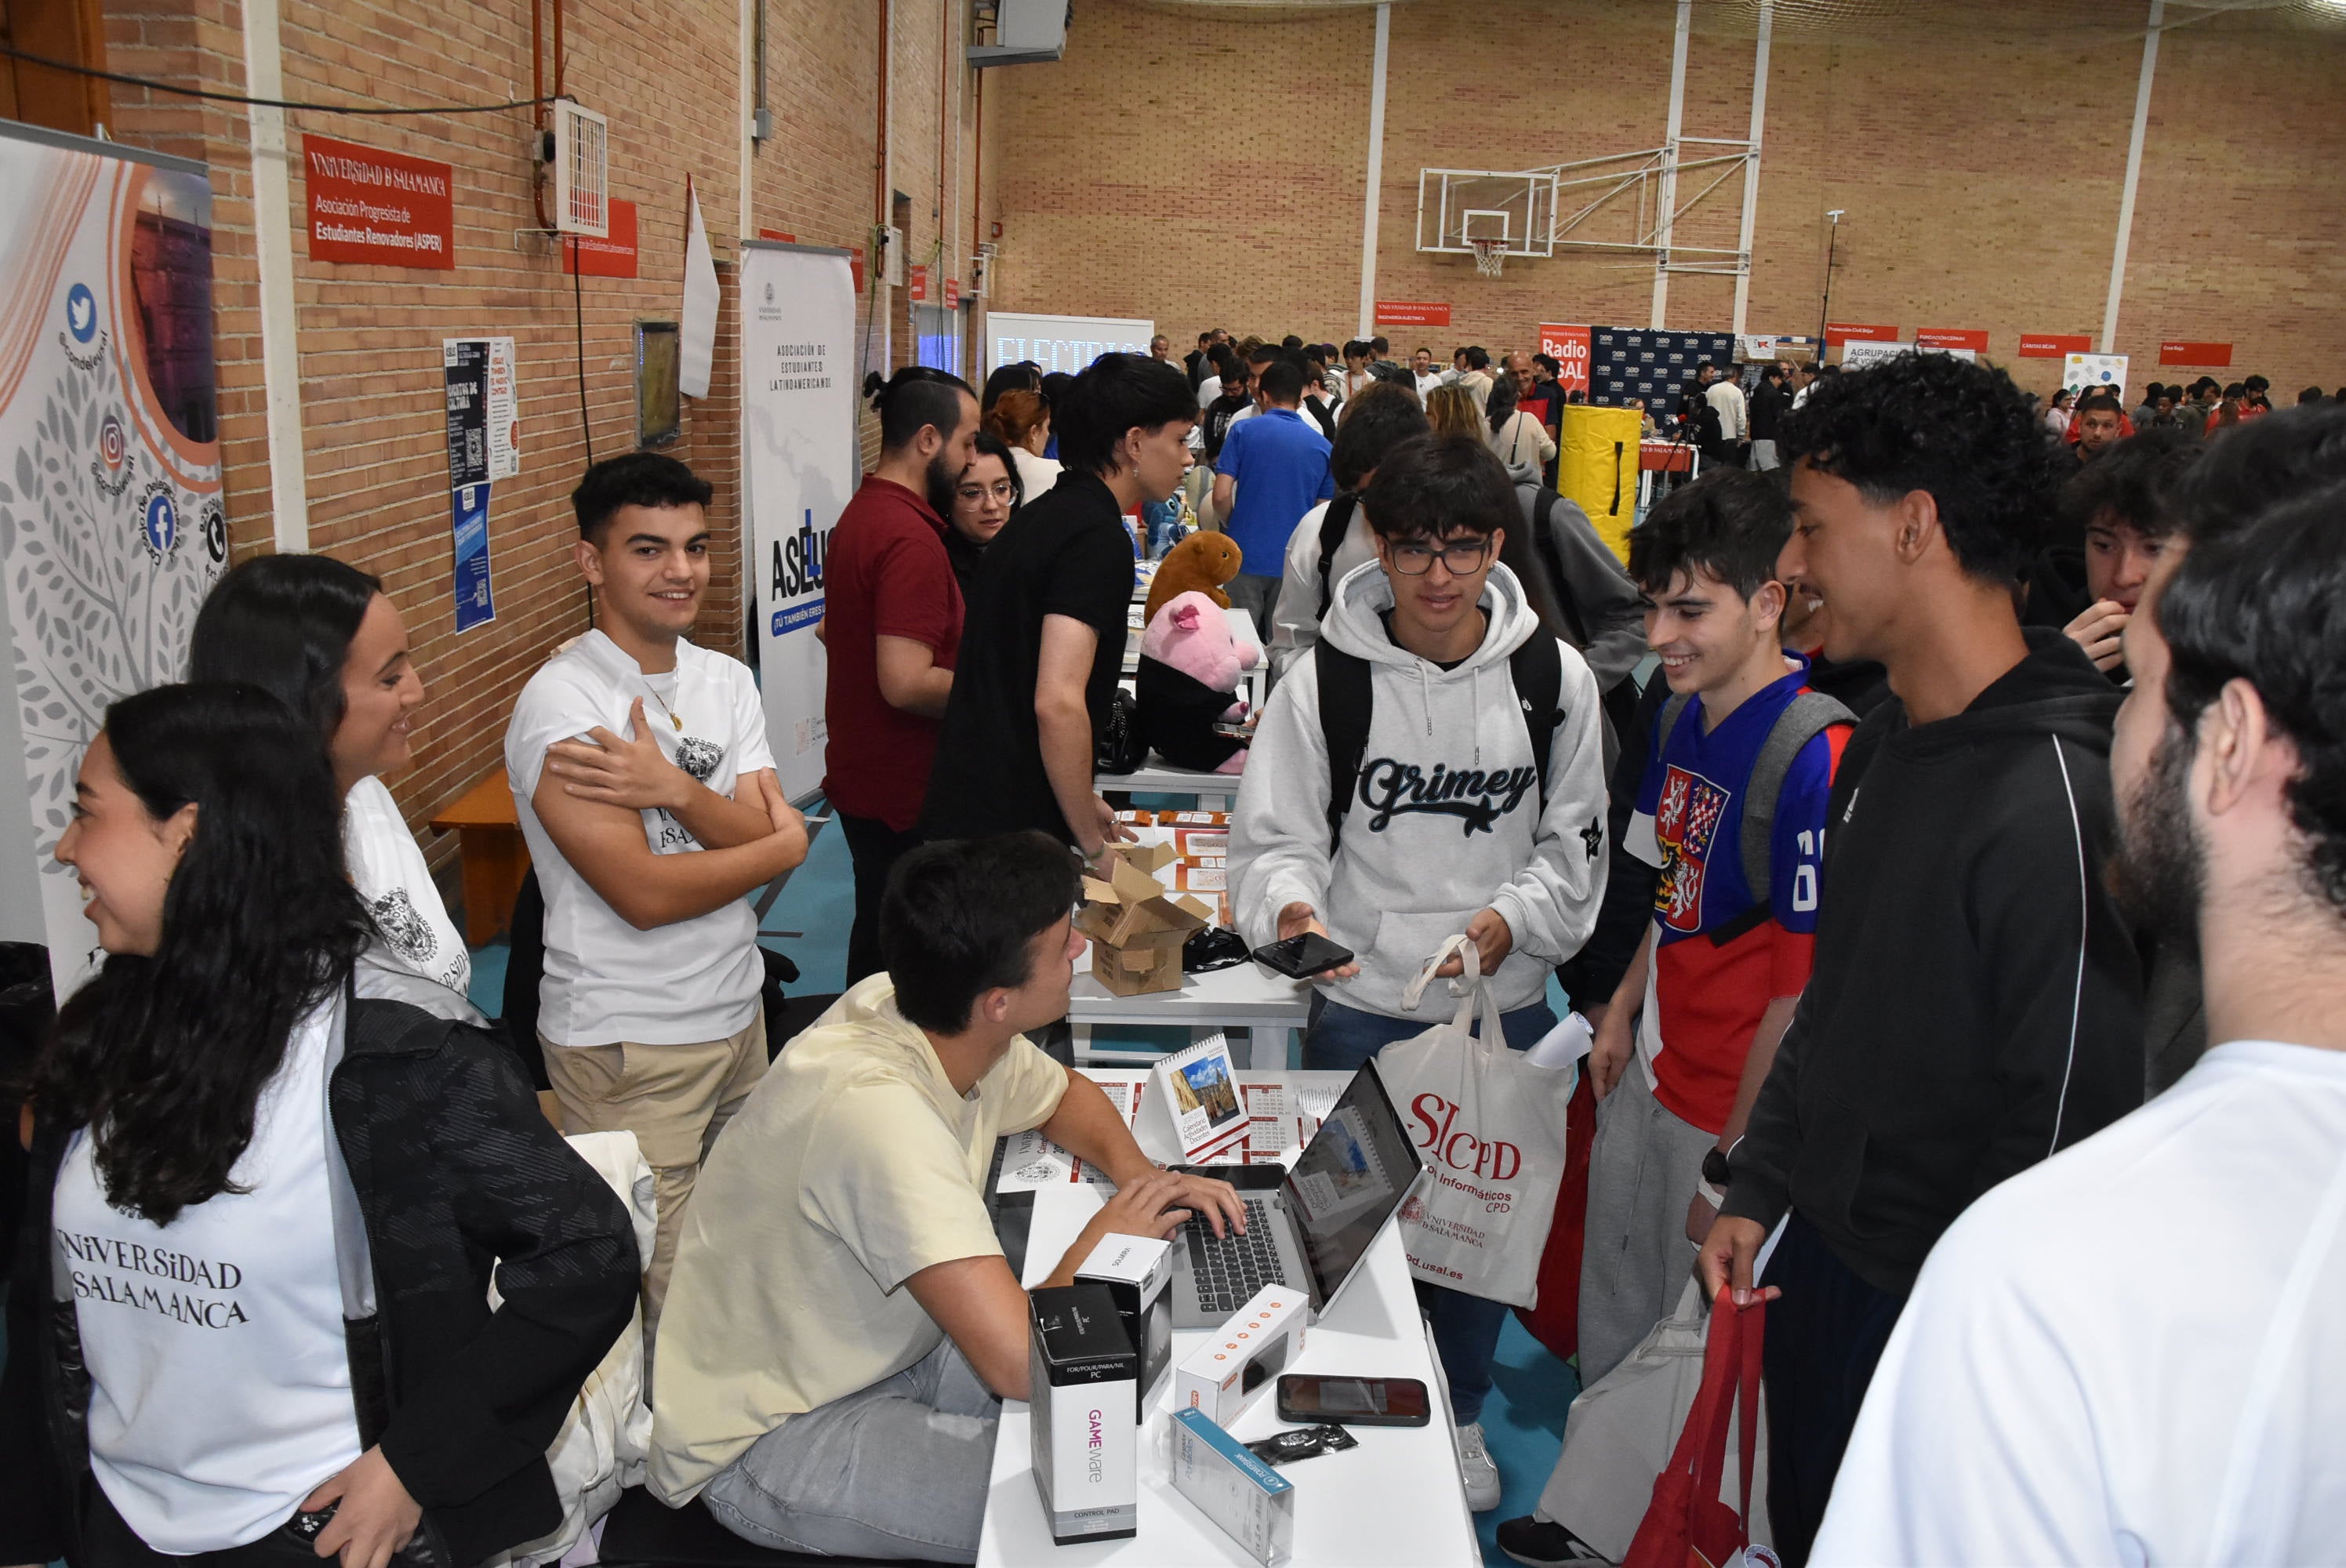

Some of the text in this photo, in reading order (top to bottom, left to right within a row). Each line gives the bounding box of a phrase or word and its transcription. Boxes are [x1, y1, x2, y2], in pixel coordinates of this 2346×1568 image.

[393, 168, 446, 197] SALAMANCA
[315, 194, 411, 223] Asociación Progresista de
[316, 221, 442, 253] Estudiantes Renovadores (ASPER)
[59, 329, 108, 371] @condeleusal
[777, 341, 826, 357] ASOCIACIÓN DE
[1542, 339, 1587, 358] Radio
[1850, 348, 1902, 358] AGRUPACI
[781, 361, 823, 374] ESTUDIANTES
[1557, 361, 1586, 379] SAL
[138, 495, 148, 514] De
[784, 608, 809, 626] TAMBIÉN
[808, 605, 822, 617] ERES
[1358, 757, 1538, 833] Grimey
[1182, 1117, 1207, 1134] Calendario
[1184, 1125, 1209, 1141] Actividades
[1189, 1131, 1211, 1145] Docentes
[1439, 1172, 1513, 1203] Informáticos
[1485, 1202, 1511, 1214] CPD
[72, 1270, 250, 1330] SALAMANCA
[1073, 1510, 1105, 1519] CONTROL
